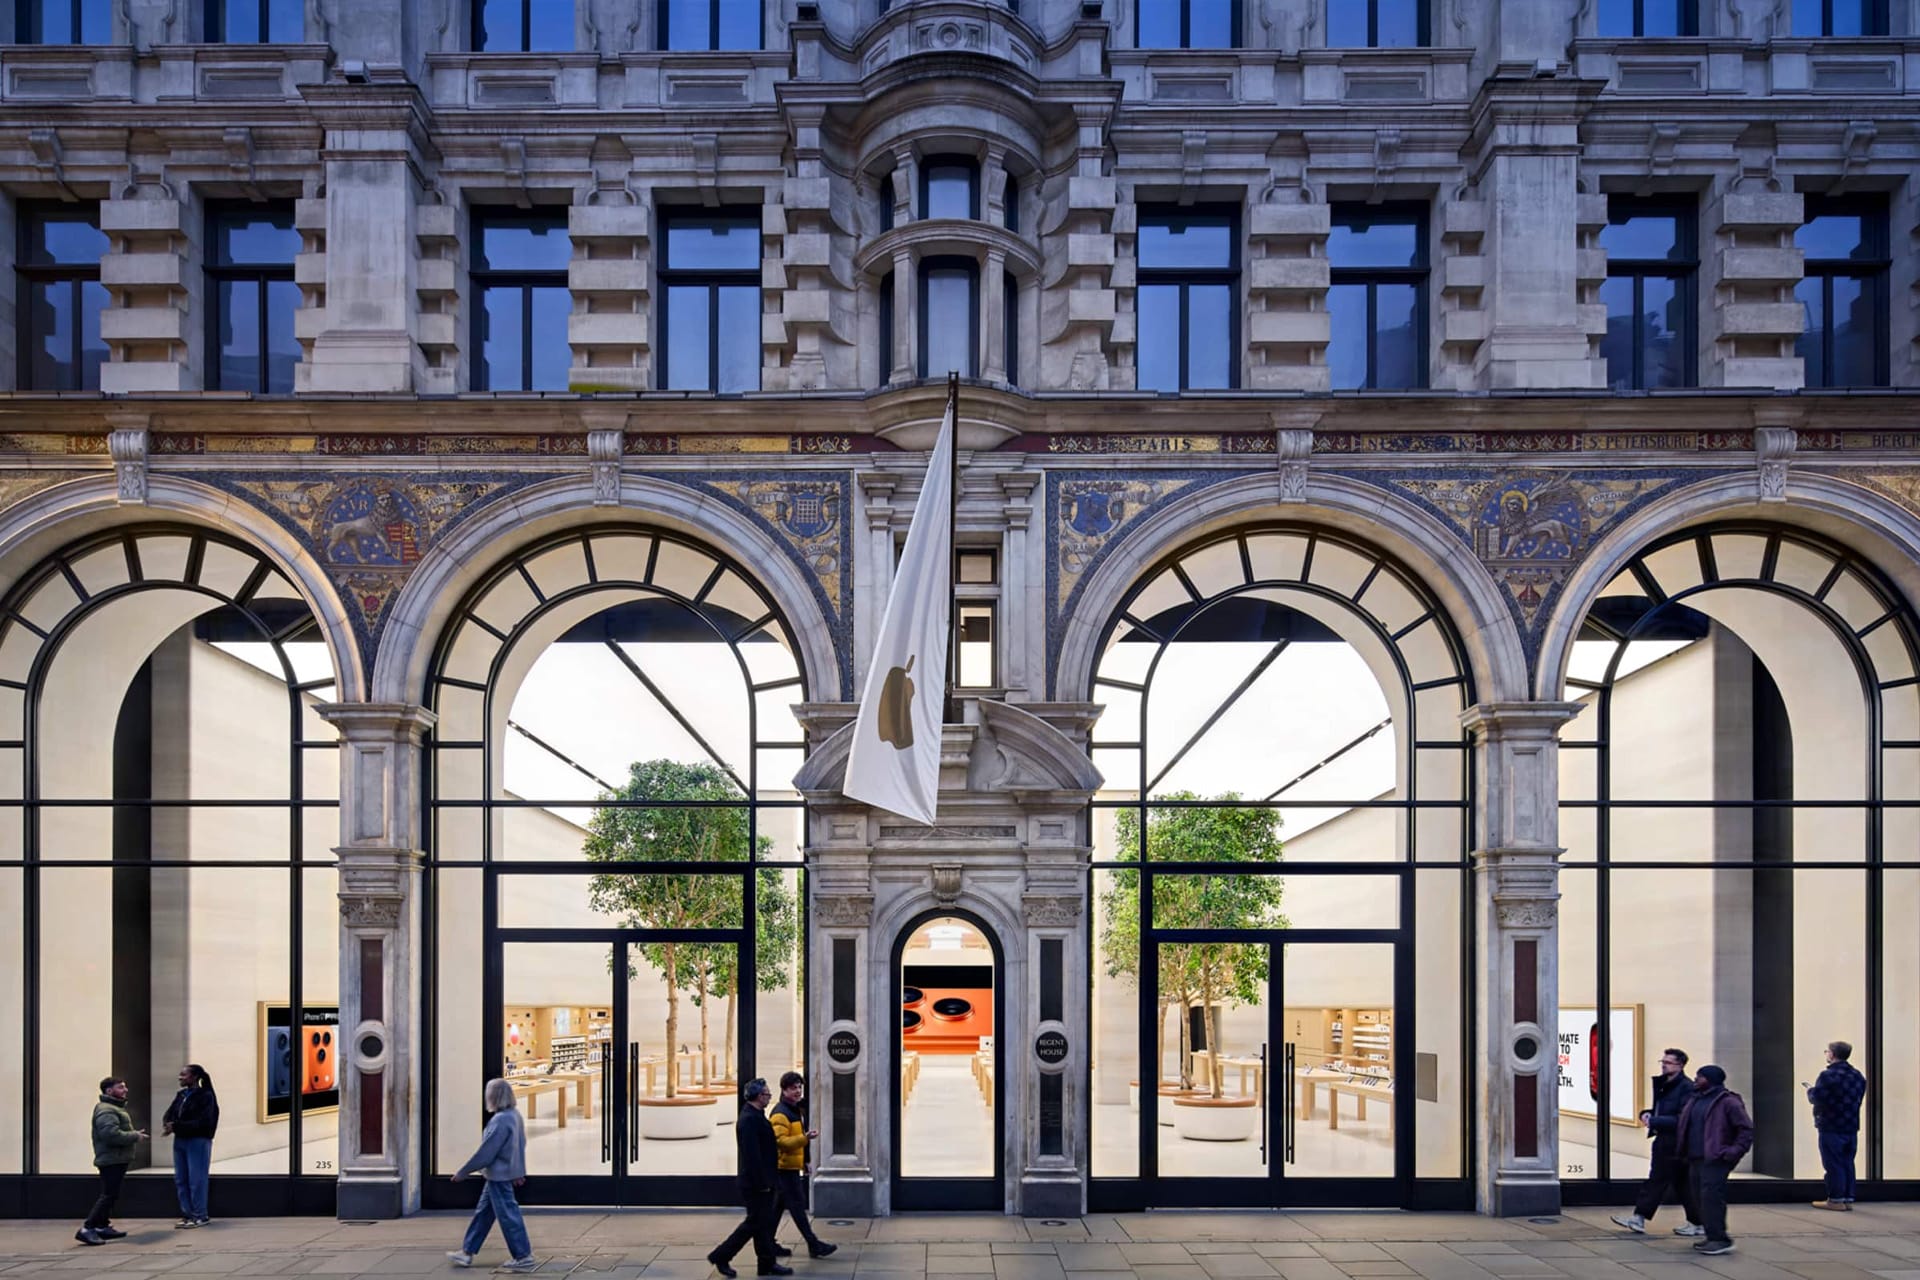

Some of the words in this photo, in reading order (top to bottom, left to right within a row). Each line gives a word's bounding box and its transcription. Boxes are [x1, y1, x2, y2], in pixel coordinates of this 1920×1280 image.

[1137, 437, 1191, 451] PARIS
[1606, 433, 1691, 449] PETERSBURG
[830, 1038, 856, 1046] REGENT
[1559, 1033, 1579, 1044] MATE
[831, 1048, 856, 1056] HOUSE
[1040, 1048, 1065, 1056] HOUSE
[1560, 1044, 1571, 1054] TO
[316, 1160, 331, 1169] 235
[1568, 1164, 1583, 1173] 235
